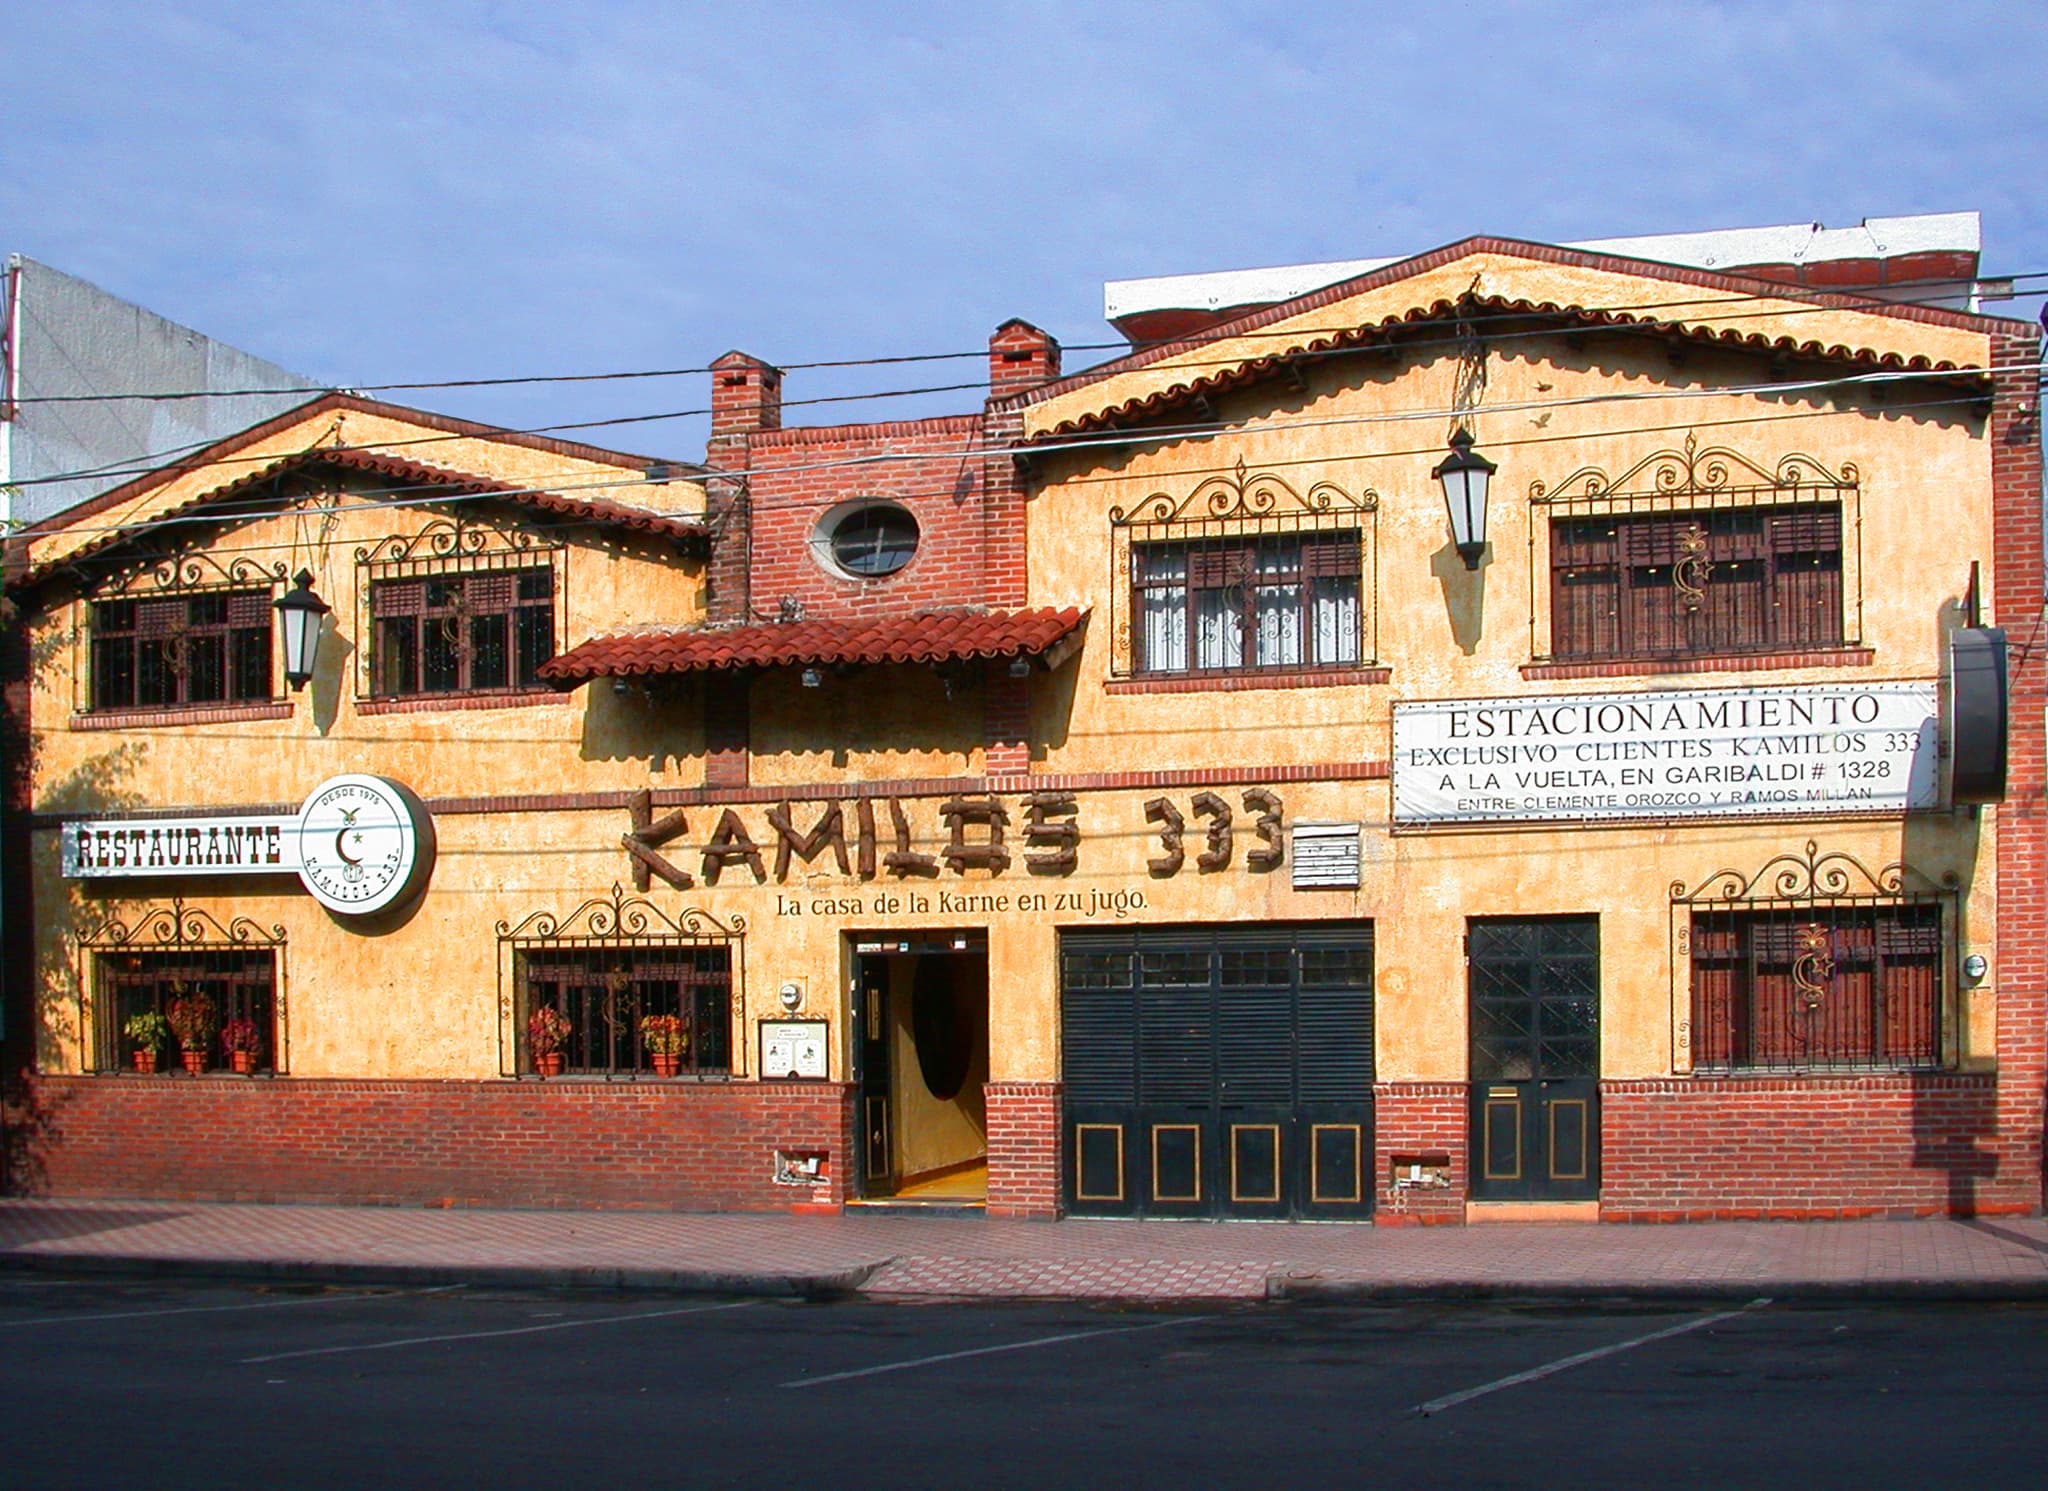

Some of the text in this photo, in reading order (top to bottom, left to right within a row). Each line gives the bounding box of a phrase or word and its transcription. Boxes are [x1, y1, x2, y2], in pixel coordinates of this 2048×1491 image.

[1448, 694, 1879, 738] ESTACIONAMIENTO
[1410, 732, 1921, 766] EXCLUSIVO CLIENTES KAMILOS 333
[1439, 774, 1455, 790] A
[1469, 773, 1501, 790] LA
[1621, 768, 1653, 785] EN
[1666, 763, 1804, 784] GARIBALDI
[1811, 763, 1826, 779] #
[1838, 760, 1891, 779] 1328
[321, 787, 380, 806] DESDE 1975
[1457, 787, 1872, 811] ENTRE CLEMENTE OROZCO Y RAMOS MILLAN
[76, 826, 281, 868] RESTAURANTE
[621, 787, 1284, 892] KAMILOS 333
[777, 888, 1148, 918] La casa de la Karne en zu jugo.
